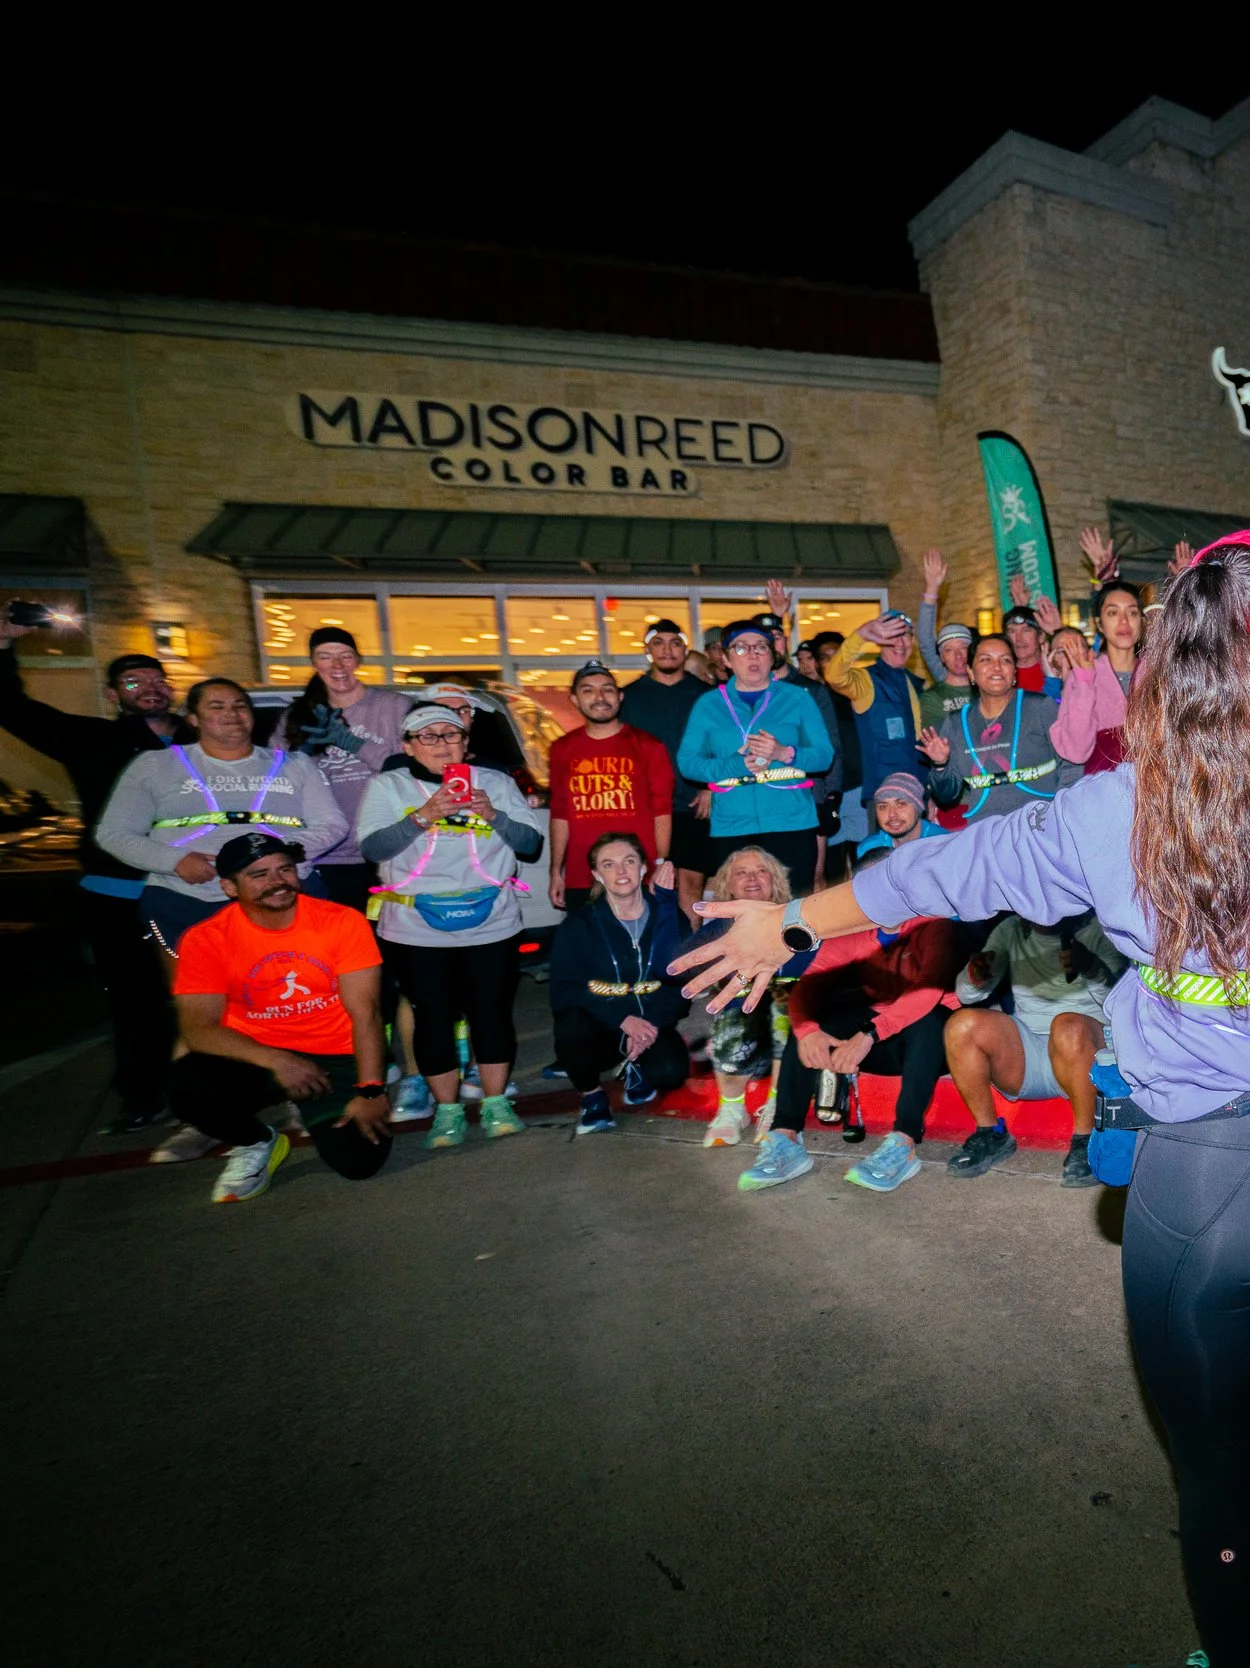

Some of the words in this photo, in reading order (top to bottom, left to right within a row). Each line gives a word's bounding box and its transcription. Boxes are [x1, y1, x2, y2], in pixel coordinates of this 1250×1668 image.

[429, 456, 586, 486] COLOR
[610, 465, 688, 491] BAR
[569, 774, 616, 795] GUTS
[446, 909, 475, 919] HOKA
